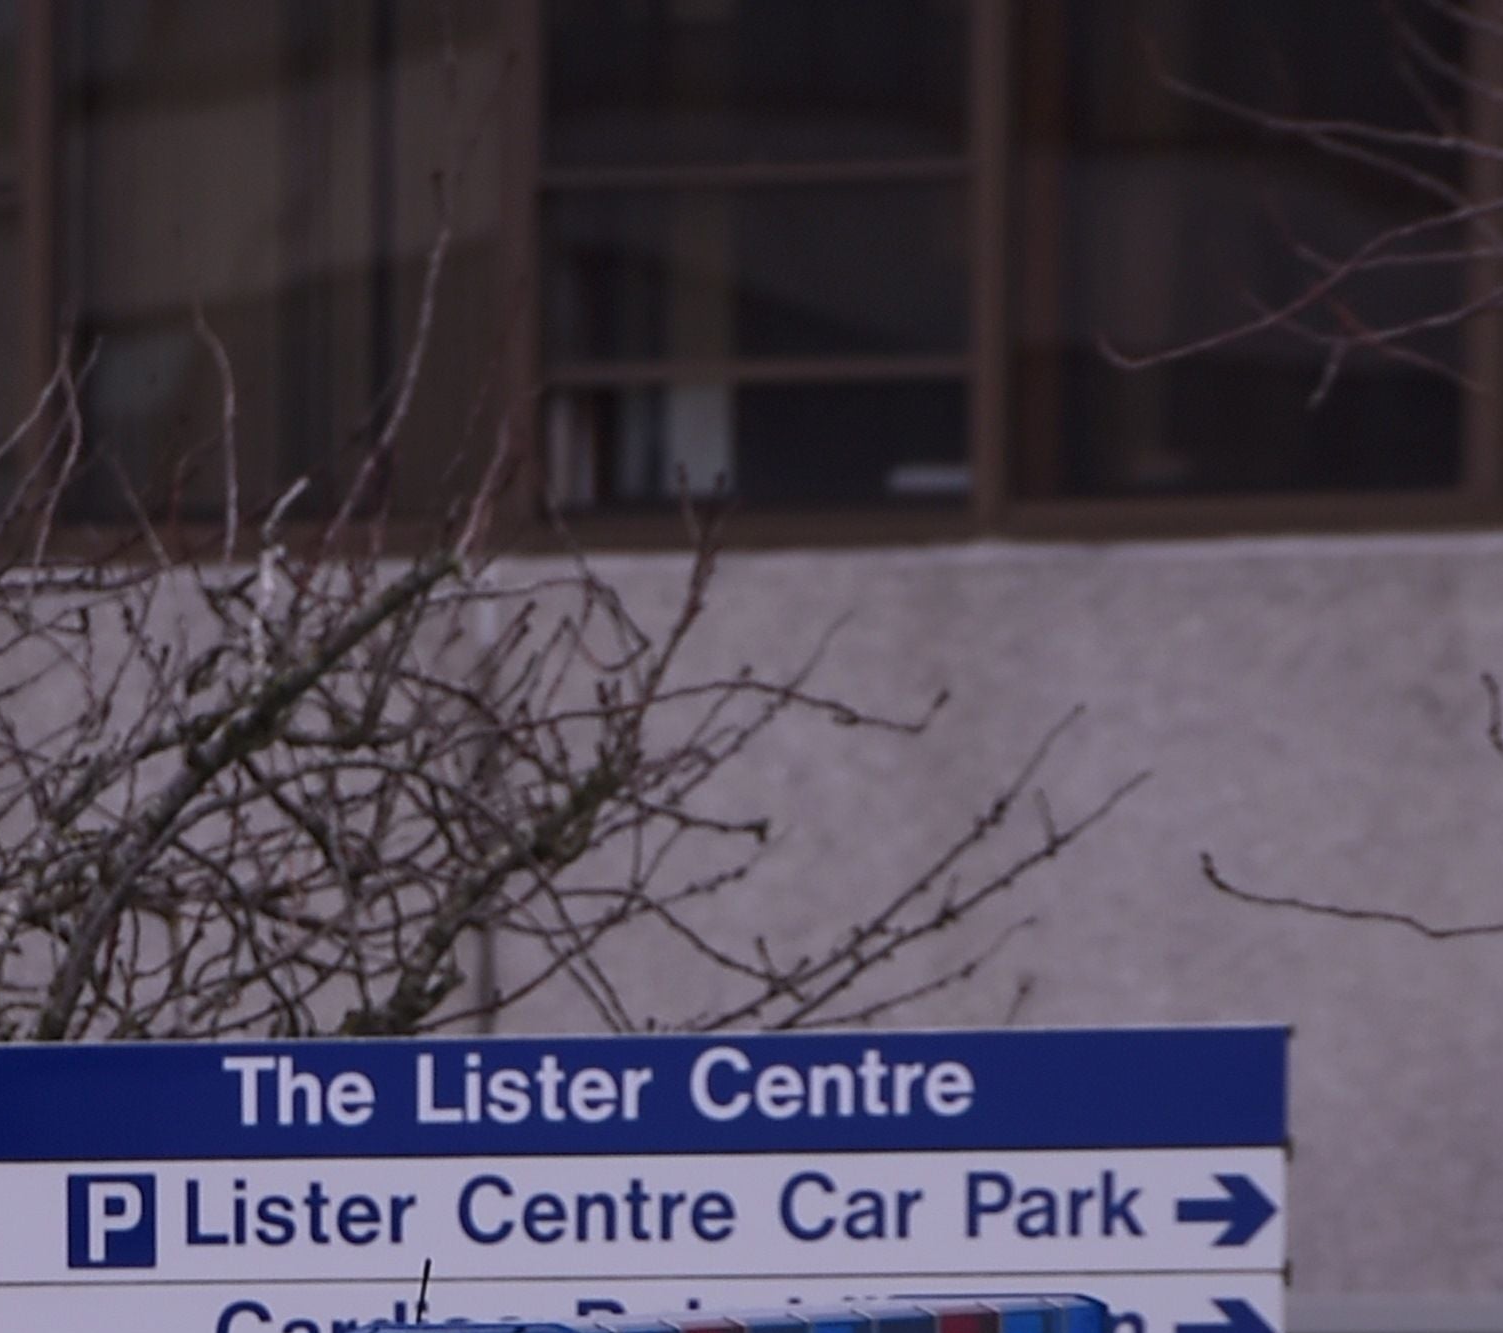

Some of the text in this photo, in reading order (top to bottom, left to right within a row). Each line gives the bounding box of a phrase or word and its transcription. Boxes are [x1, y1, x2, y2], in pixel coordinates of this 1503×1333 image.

[222, 1045, 975, 1126] The Lister Centre
[88, 1169, 1145, 1262] P Lister Centre Car Park
